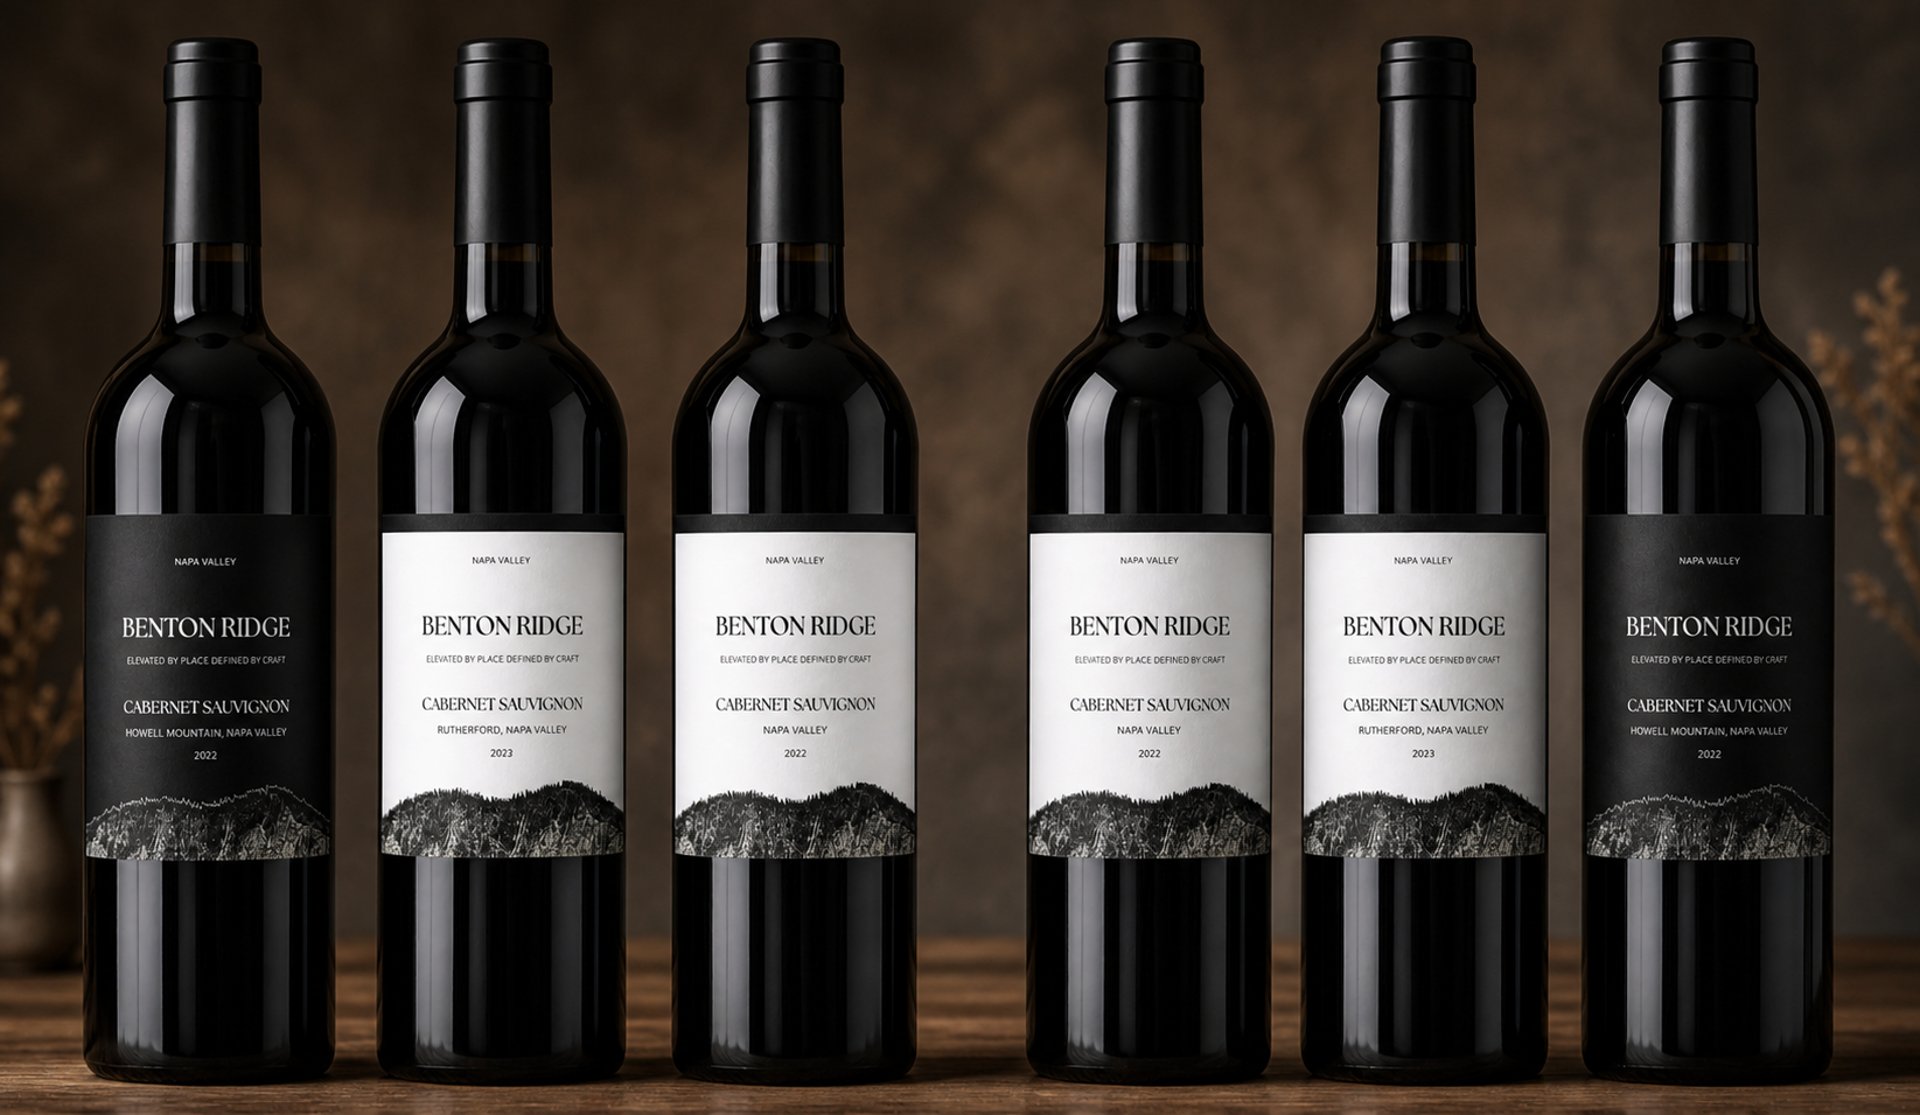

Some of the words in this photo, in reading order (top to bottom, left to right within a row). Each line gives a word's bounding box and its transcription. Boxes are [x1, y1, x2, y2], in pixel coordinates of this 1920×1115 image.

[175, 556, 199, 567] NAPA
[202, 556, 236, 567] VALLEY
[472, 555, 496, 565] NAPA
[498, 555, 530, 565] VALLEY
[766, 555, 790, 565] NAPA
[792, 555, 824, 565] VALLEY
[1120, 556, 1144, 565] NAPA
[1146, 556, 1178, 565] VALLEY
[1394, 556, 1418, 566] NAPA
[1420, 556, 1452, 566] VALLEY
[1679, 555, 1704, 566] NAPA
[1706, 555, 1740, 566] VALLEY
[123, 617, 215, 638] BENTON
[221, 617, 290, 638] RIDGE
[422, 615, 511, 636] BENTON
[517, 615, 583, 636] RIDGE
[716, 616, 805, 636] BENTON
[811, 616, 876, 636] RIDGE
[1071, 616, 1159, 636] BENTON
[1165, 616, 1230, 636] RIDGE
[1344, 616, 1433, 636] BENTON
[1439, 616, 1505, 636] RIDGE
[1627, 616, 1719, 637] BENTON
[1725, 616, 1792, 637] RIDGE
[127, 655, 165, 666] ELEVATED
[168, 655, 178, 666] BY
[181, 655, 208, 666] PLACE
[211, 655, 249, 666] DEFINED
[251, 655, 261, 666] BY
[263, 655, 286, 666] CRAFT
[427, 654, 463, 664] ELEVATED
[465, 654, 475, 664] BY
[477, 654, 504, 664] PLACE
[506, 654, 542, 664] DEFINED
[544, 654, 554, 664] BY
[556, 654, 580, 664] CRAFT
[720, 654, 757, 664] ELEVATED
[759, 654, 769, 664] BY
[771, 654, 798, 664] PLACE
[800, 654, 836, 664] DEFINED
[838, 654, 847, 664] BY
[849, 654, 871, 664] CRAFT
[1075, 655, 1111, 665] ELEVATED
[1113, 655, 1123, 665] BY
[1125, 655, 1152, 665] PLACE
[1154, 655, 1189, 665] DEFINED
[1191, 655, 1201, 665] BY
[1202, 655, 1226, 665] CRAFT
[1348, 655, 1385, 665] ELEVATED
[1387, 655, 1398, 665] BY
[1400, 655, 1426, 665] PLACE
[1429, 655, 1464, 665] DEFINED
[1466, 655, 1476, 665] BY
[1478, 655, 1500, 665] CRAFT
[1631, 655, 1670, 665] ELEVATED
[1672, 655, 1683, 665] BY
[1685, 655, 1713, 665] PLACE
[1716, 655, 1752, 665] DEFINED
[1754, 655, 1764, 665] BY
[1766, 655, 1788, 665] CRAFT
[124, 698, 200, 714] CABERNET
[202, 698, 290, 714] SAUVIGNON
[422, 696, 496, 711] CABERNET
[499, 696, 583, 711] SAUVIGNON
[716, 696, 790, 711] CABERNET
[793, 696, 876, 711] SAUVIGNON
[1070, 697, 1144, 711] CABERNET
[1147, 697, 1230, 711] SAUVIGNON
[1343, 697, 1418, 712] CABERNET
[1420, 697, 1504, 712] SAUVIGNON
[1628, 698, 1704, 713] CABERNET
[1708, 698, 1791, 713] SAUVIGNON
[125, 727, 164, 738] HOWELL
[166, 727, 224, 738] MOUNTAIN,
[226, 727, 253, 738] NAPA
[254, 727, 287, 738] VALLEY
[438, 724, 503, 735] RUTHERFORD,
[506, 724, 532, 735] NAPA
[534, 724, 566, 735] VALLEY
[763, 725, 789, 734] NAPA
[792, 725, 827, 734] VALLEY
[1117, 725, 1143, 735] NAPA
[1146, 725, 1181, 735] VALLEY
[1359, 725, 1424, 735] RUTHERFORD,
[1427, 725, 1453, 735] NAPA
[1455, 725, 1488, 735] VALLEY
[1631, 726, 1668, 736] HOWELL
[1671, 726, 1728, 736] MOUNTAIN,
[1730, 726, 1755, 736] NAPA
[1757, 726, 1788, 736] VALLEY
[194, 750, 217, 761] 2022
[491, 748, 513, 758] 2023
[785, 748, 806, 758] 2022
[1139, 749, 1160, 759] 2022
[1412, 748, 1435, 759] 2023
[1698, 749, 1721, 759] 2022
